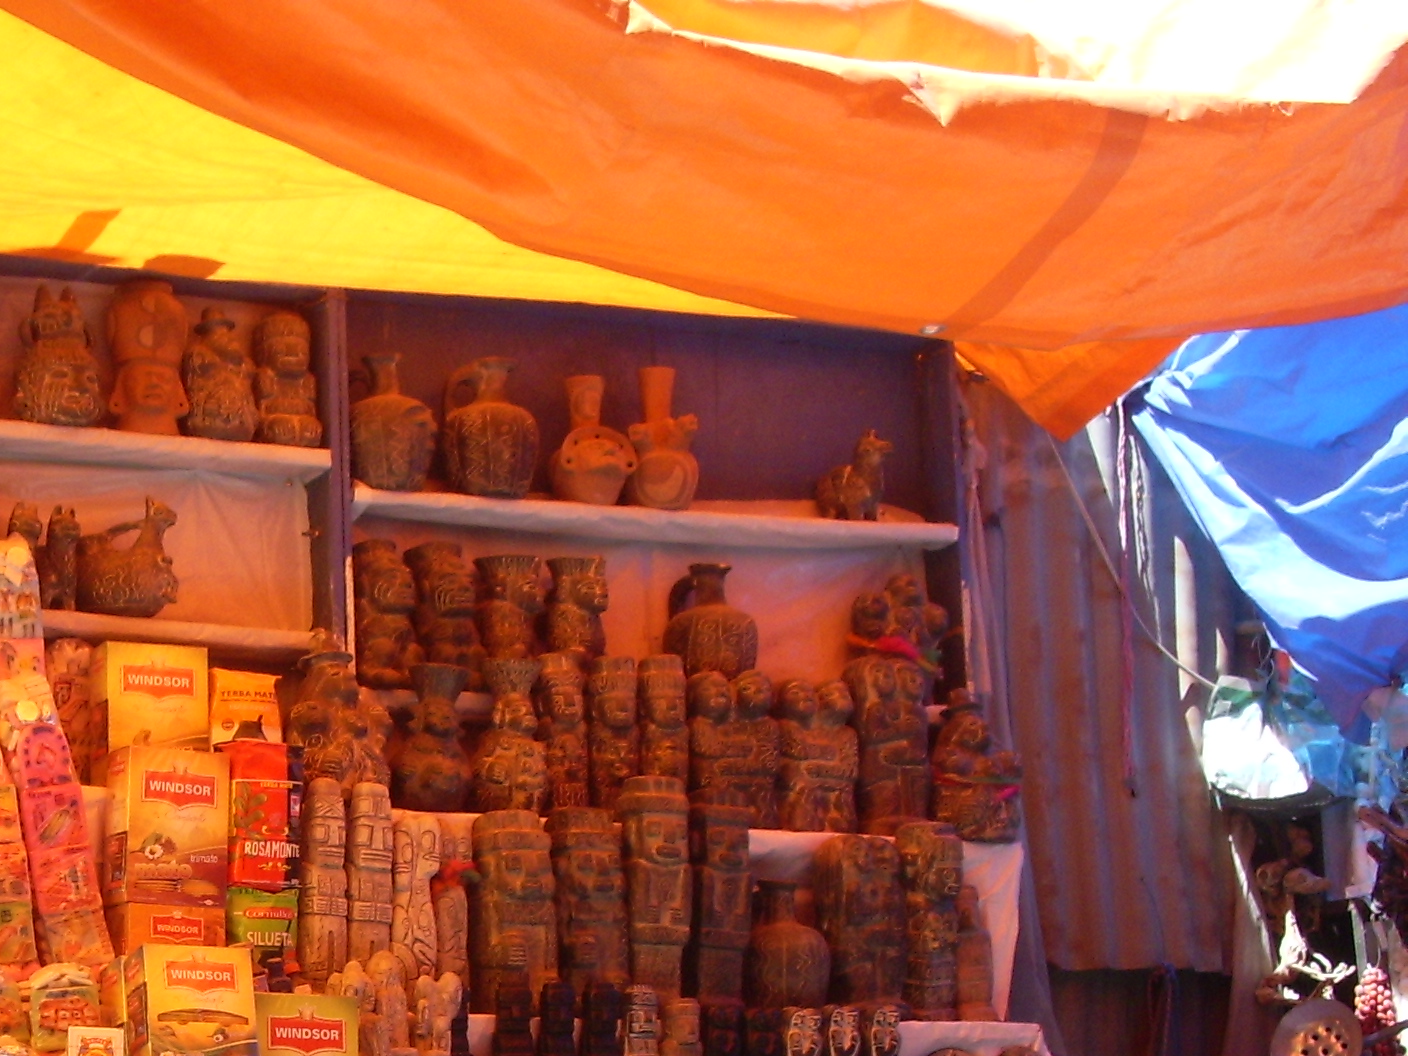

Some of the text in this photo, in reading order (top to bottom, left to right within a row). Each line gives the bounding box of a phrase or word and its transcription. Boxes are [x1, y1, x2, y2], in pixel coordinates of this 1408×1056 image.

[128, 674, 190, 688] WINDSOR
[221, 690, 275, 700] YERBA MAT
[149, 780, 212, 797] WINDSOR
[244, 841, 301, 859] ROSAMONTE
[156, 924, 199, 935] WINDSOR
[246, 931, 294, 948] SILUETA
[170, 968, 232, 982] WINDSOR
[275, 1027, 340, 1041] WINDSOR
